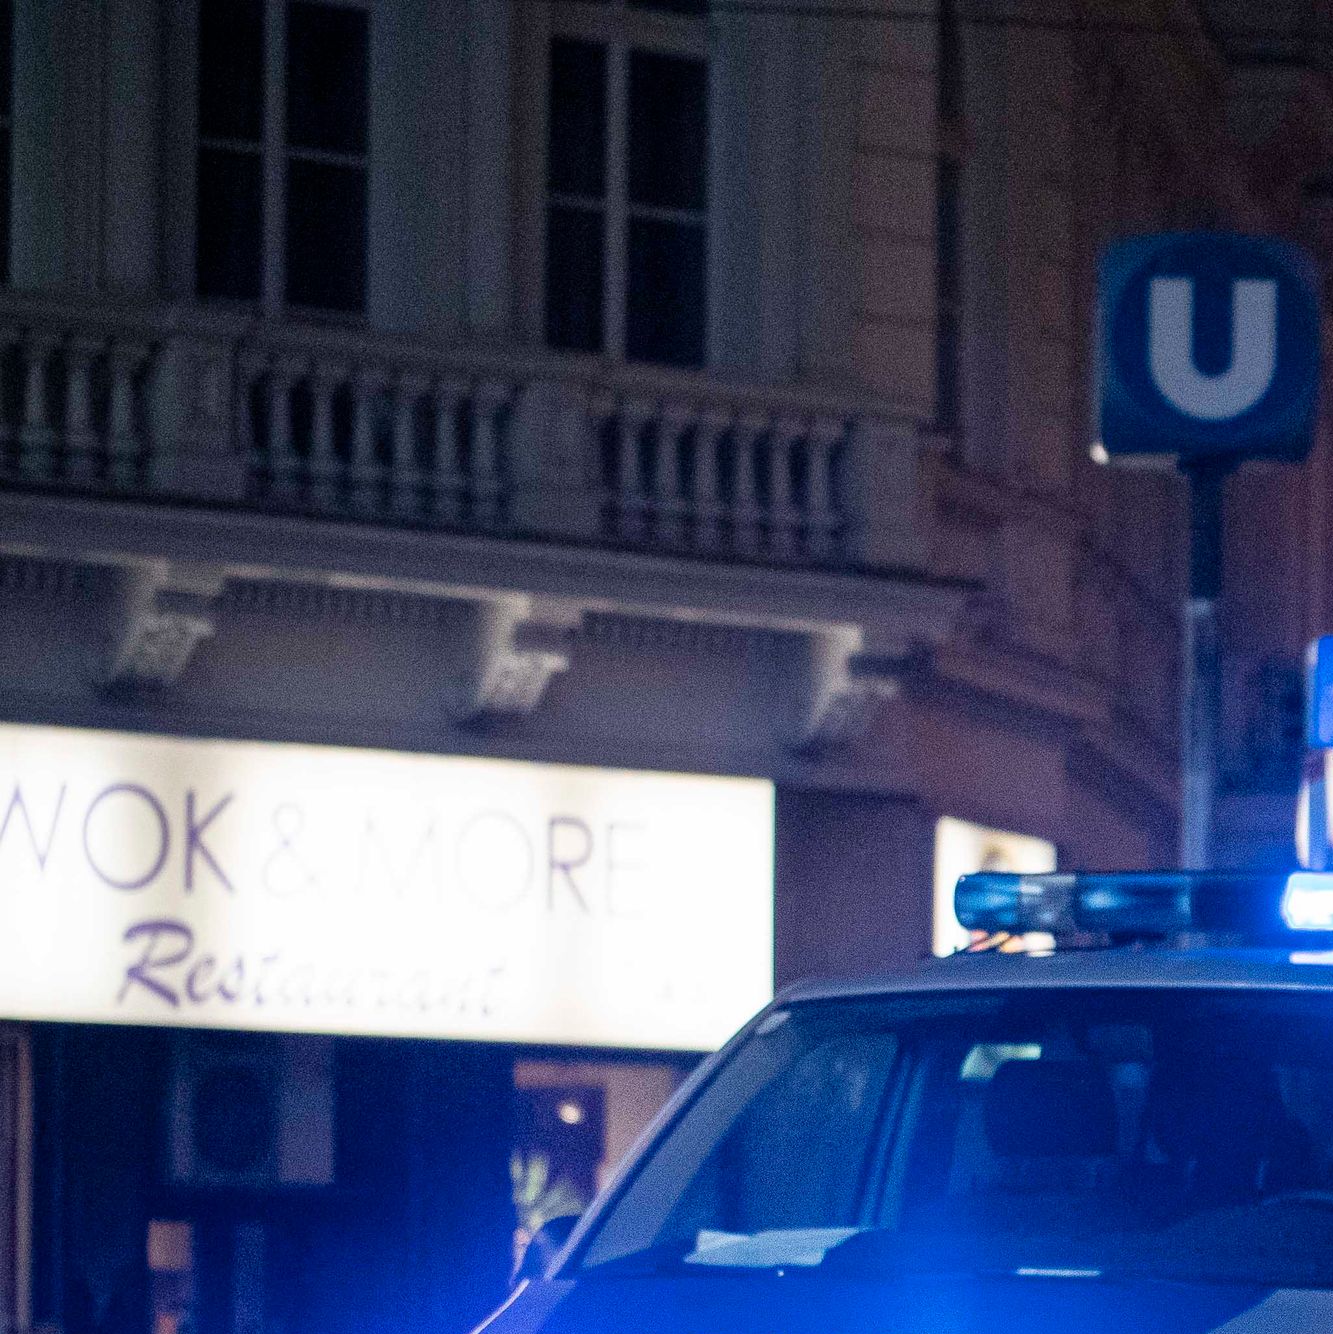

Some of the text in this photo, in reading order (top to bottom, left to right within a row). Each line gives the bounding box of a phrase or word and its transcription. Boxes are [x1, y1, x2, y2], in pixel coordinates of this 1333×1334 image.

[1148, 275, 1278, 420] U
[260, 800, 322, 900] &
[355, 807, 648, 920] MORE
[116, 911, 507, 1019] Restaurant
